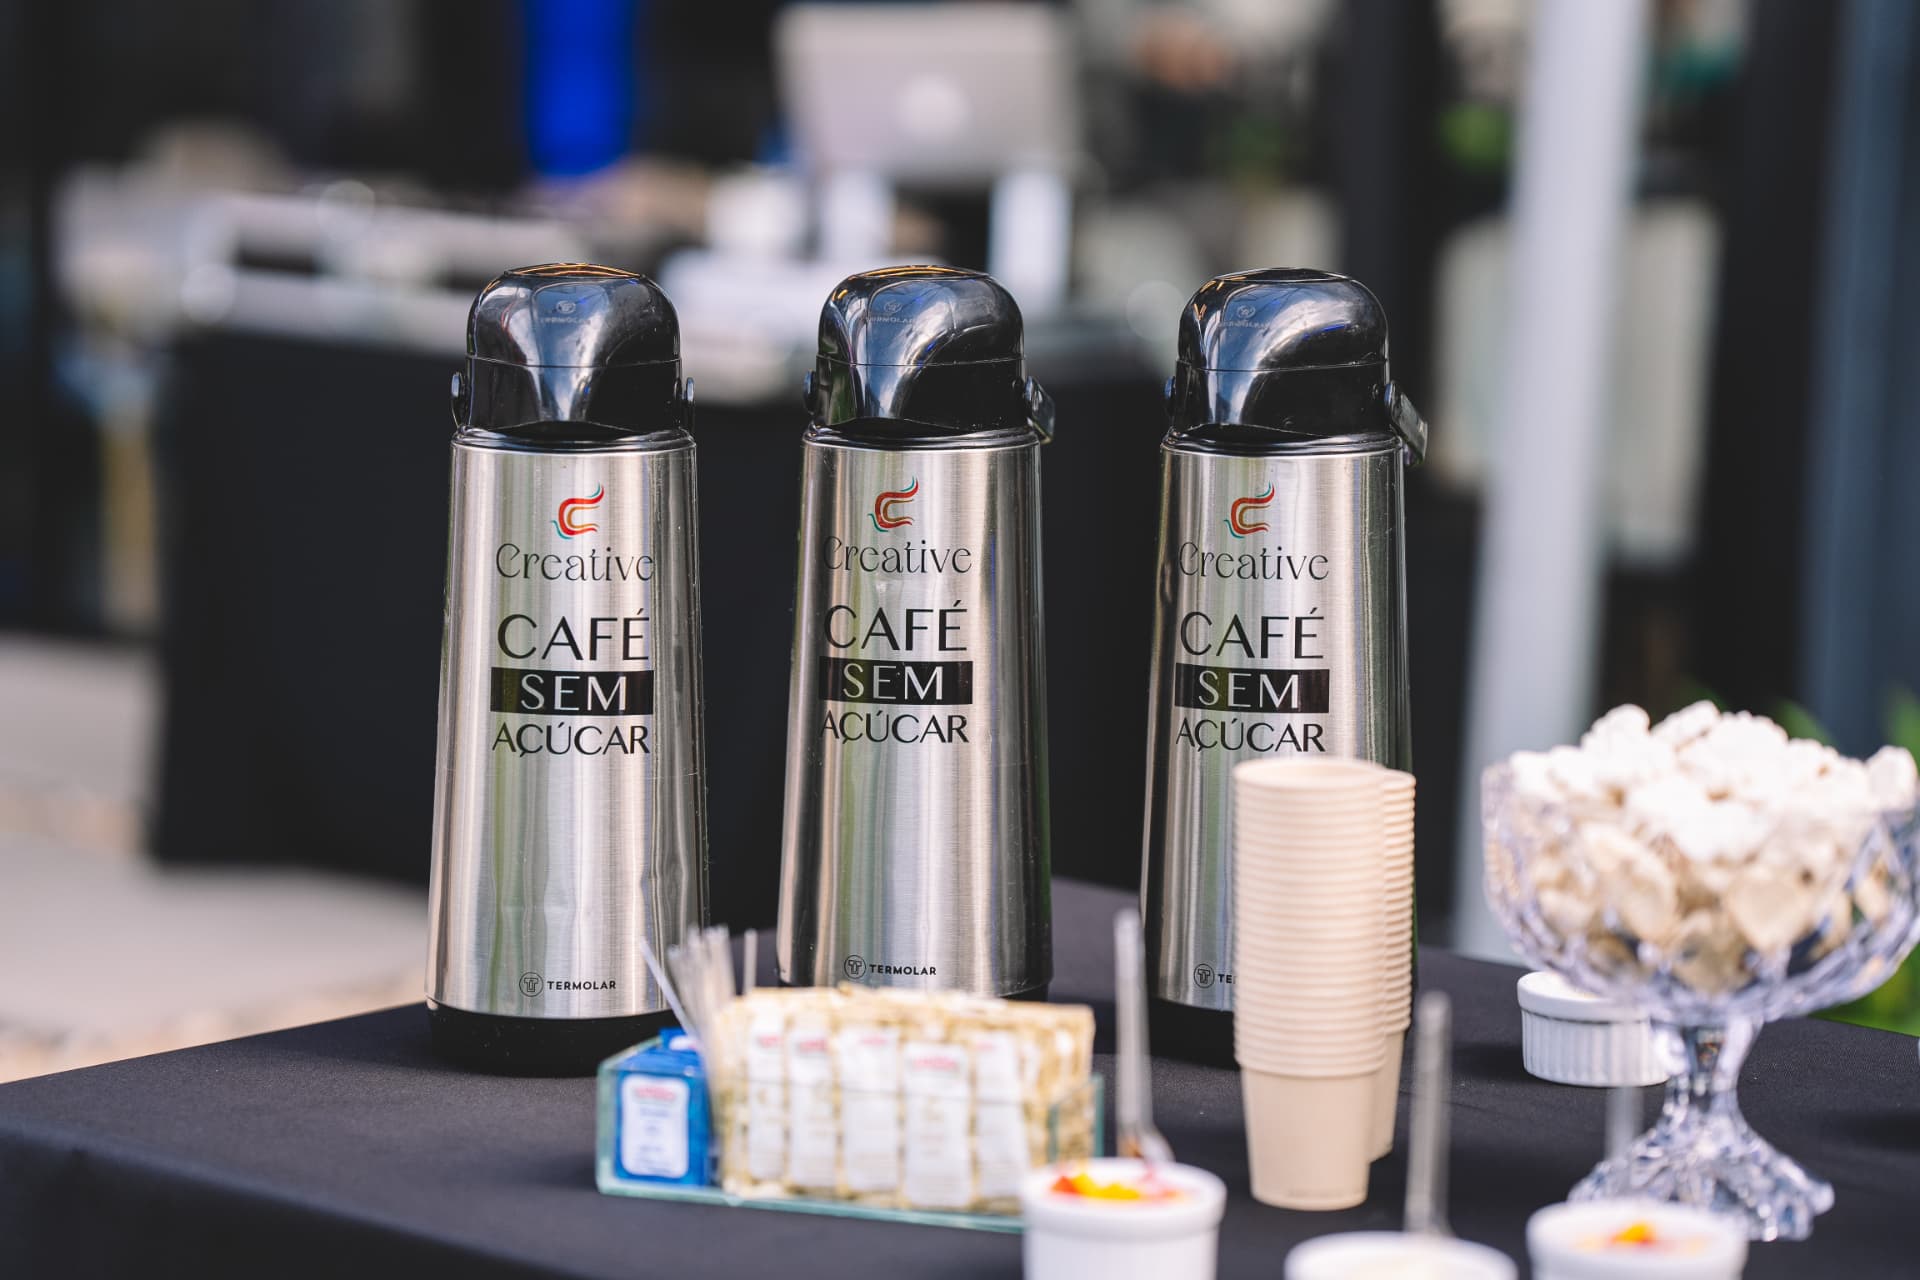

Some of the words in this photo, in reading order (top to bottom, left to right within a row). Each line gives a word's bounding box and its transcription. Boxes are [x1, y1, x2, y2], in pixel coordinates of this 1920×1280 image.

[495, 543, 655, 581] Creative
[822, 535, 972, 573] Creative
[1179, 541, 1329, 580] Creative
[497, 608, 650, 661] CAFÉ
[823, 600, 968, 651] CAFÉ
[1180, 607, 1325, 659] CAFÉ
[520, 673, 627, 712] SEM
[842, 663, 944, 701] SEM
[1198, 670, 1299, 709] SEM
[492, 721, 651, 757] AÇÚCAR
[820, 710, 970, 744] AÇÚCAR
[1176, 717, 1326, 752] AÇÚCAR
[546, 980, 617, 991] TERMOLAR
[869, 964, 937, 976] TERMOLAR
